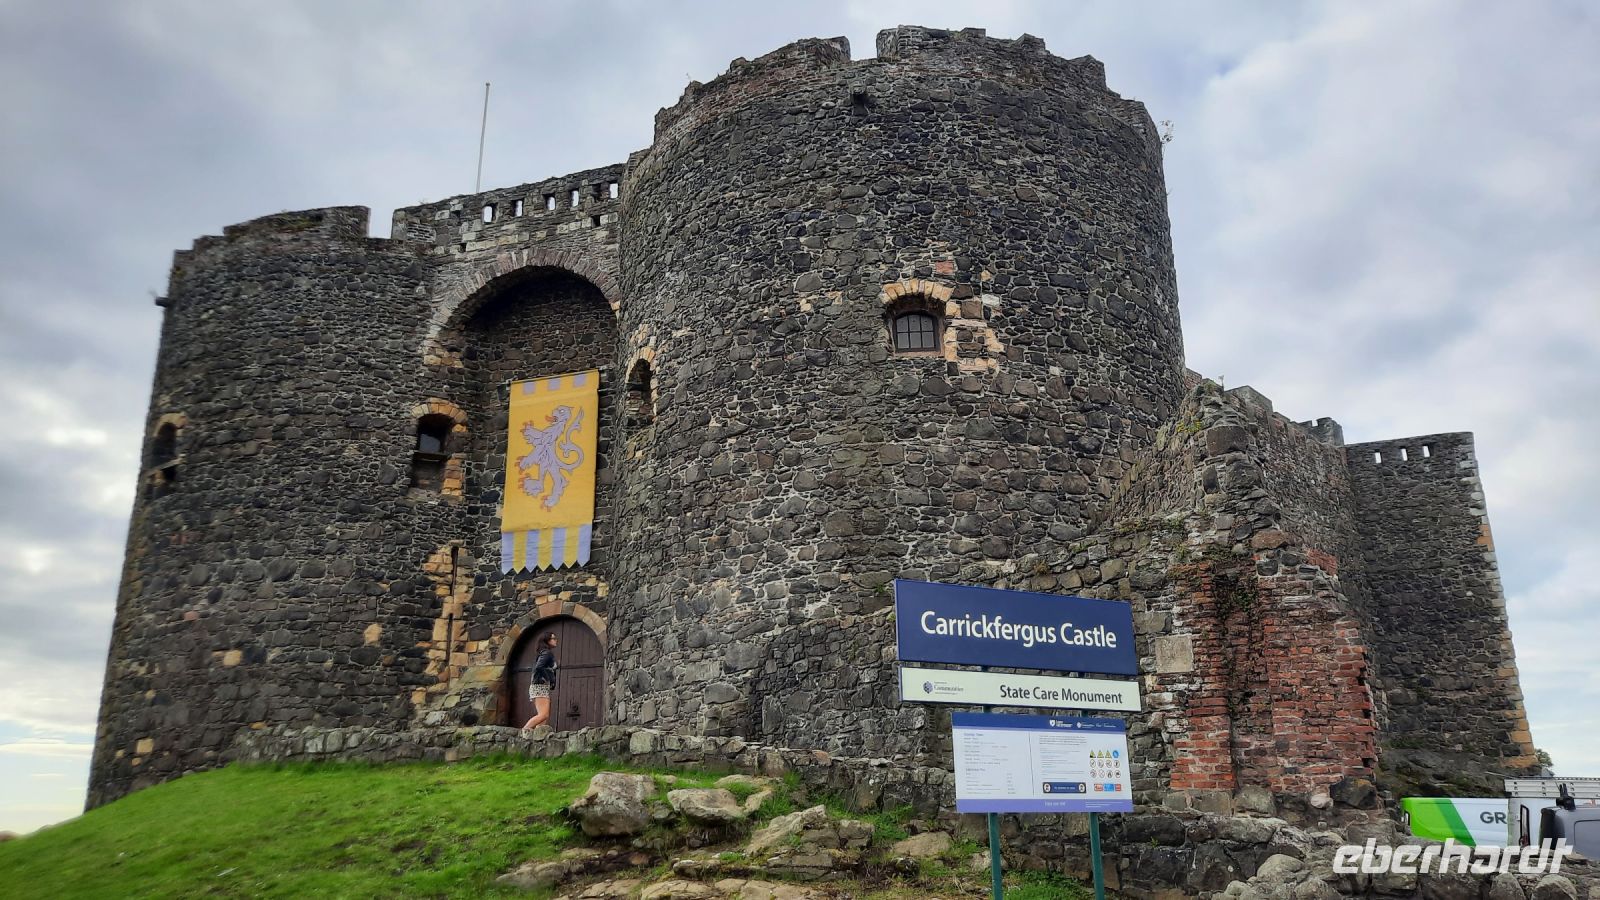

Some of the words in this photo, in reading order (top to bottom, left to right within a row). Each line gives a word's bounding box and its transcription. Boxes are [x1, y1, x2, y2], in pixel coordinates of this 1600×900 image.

[920, 611, 1057, 647] Carrickfergus
[1060, 622, 1117, 649] Castle
[1000, 684, 1031, 699] State
[1033, 687, 1059, 701] Care
[1061, 689, 1123, 704] Monument
[1480, 811, 1508, 824] GR
